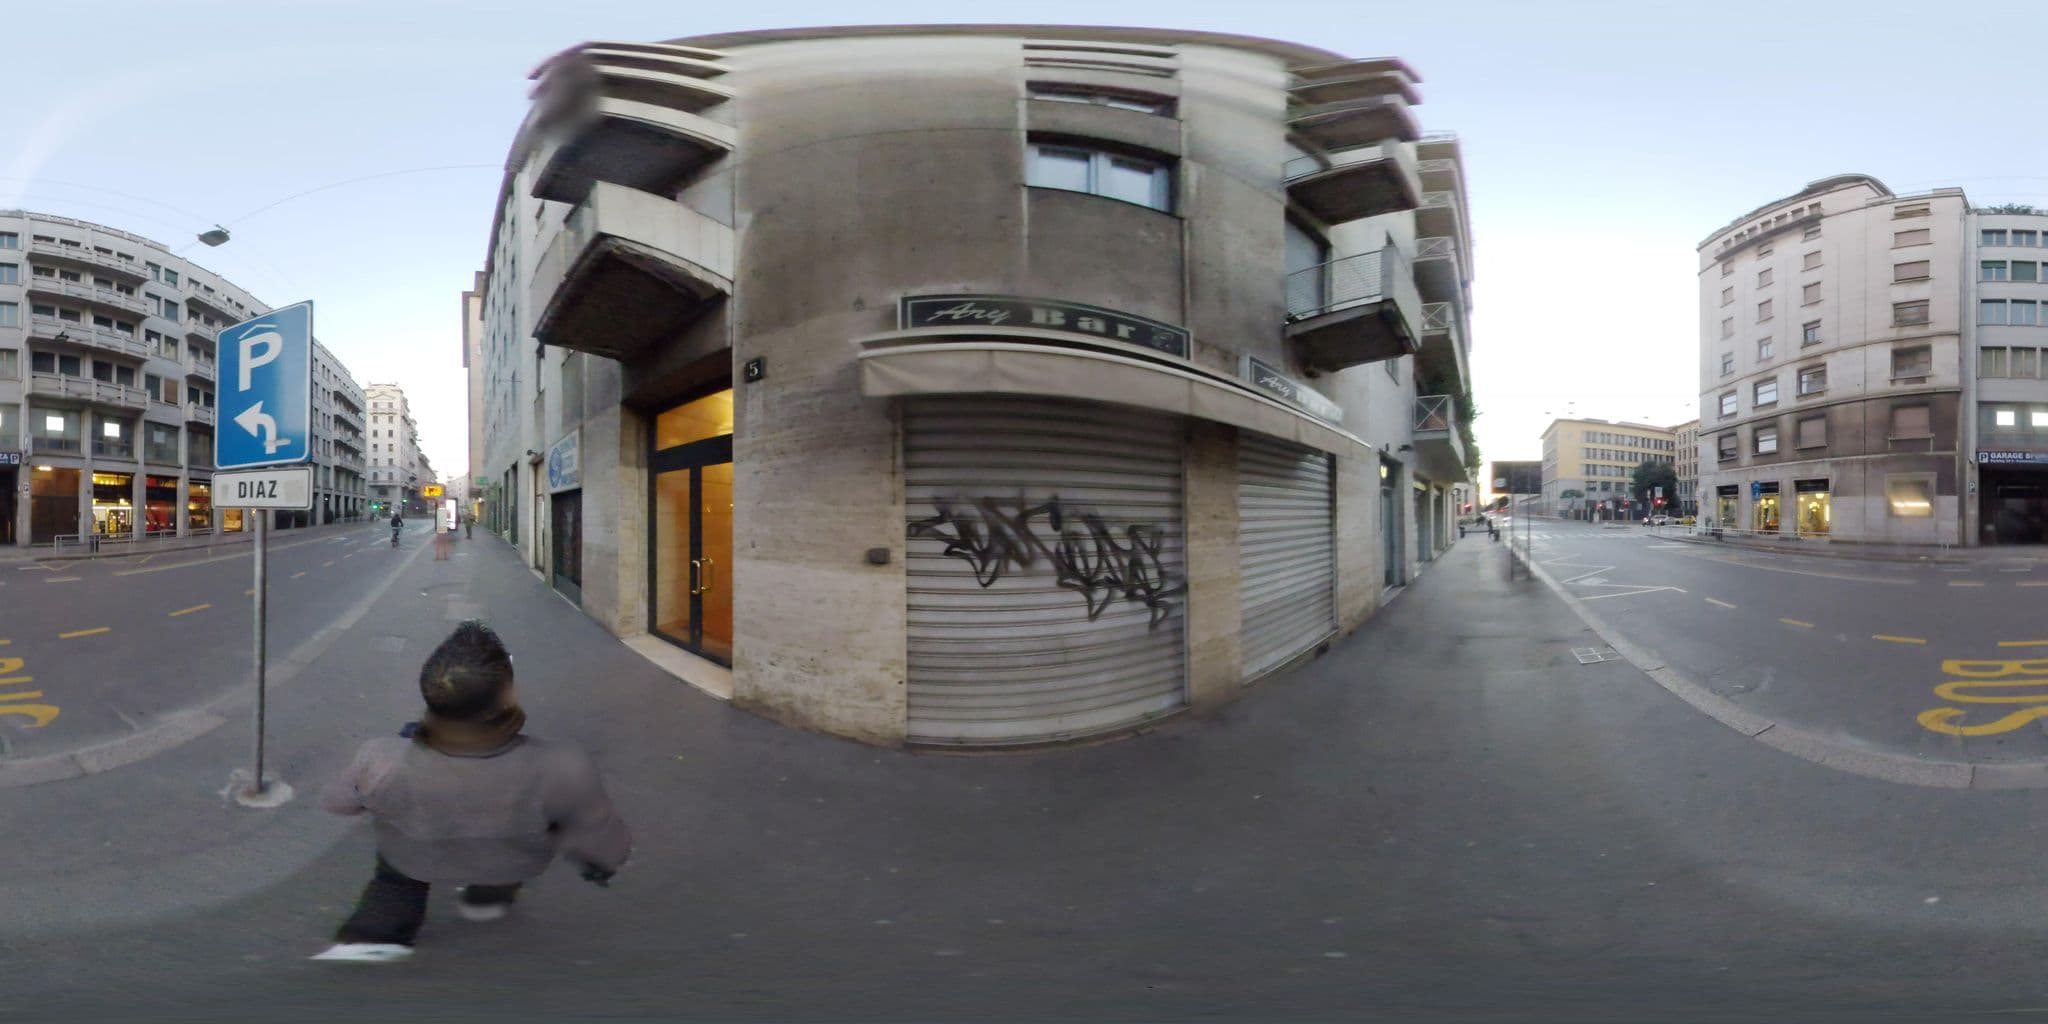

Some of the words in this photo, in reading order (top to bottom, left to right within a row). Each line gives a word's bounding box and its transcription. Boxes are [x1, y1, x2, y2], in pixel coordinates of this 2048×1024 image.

[1032, 307, 1136, 338] Bar
[239, 331, 283, 392] P
[749, 362, 759, 377] 5
[238, 480, 278, 499] DIAZ
